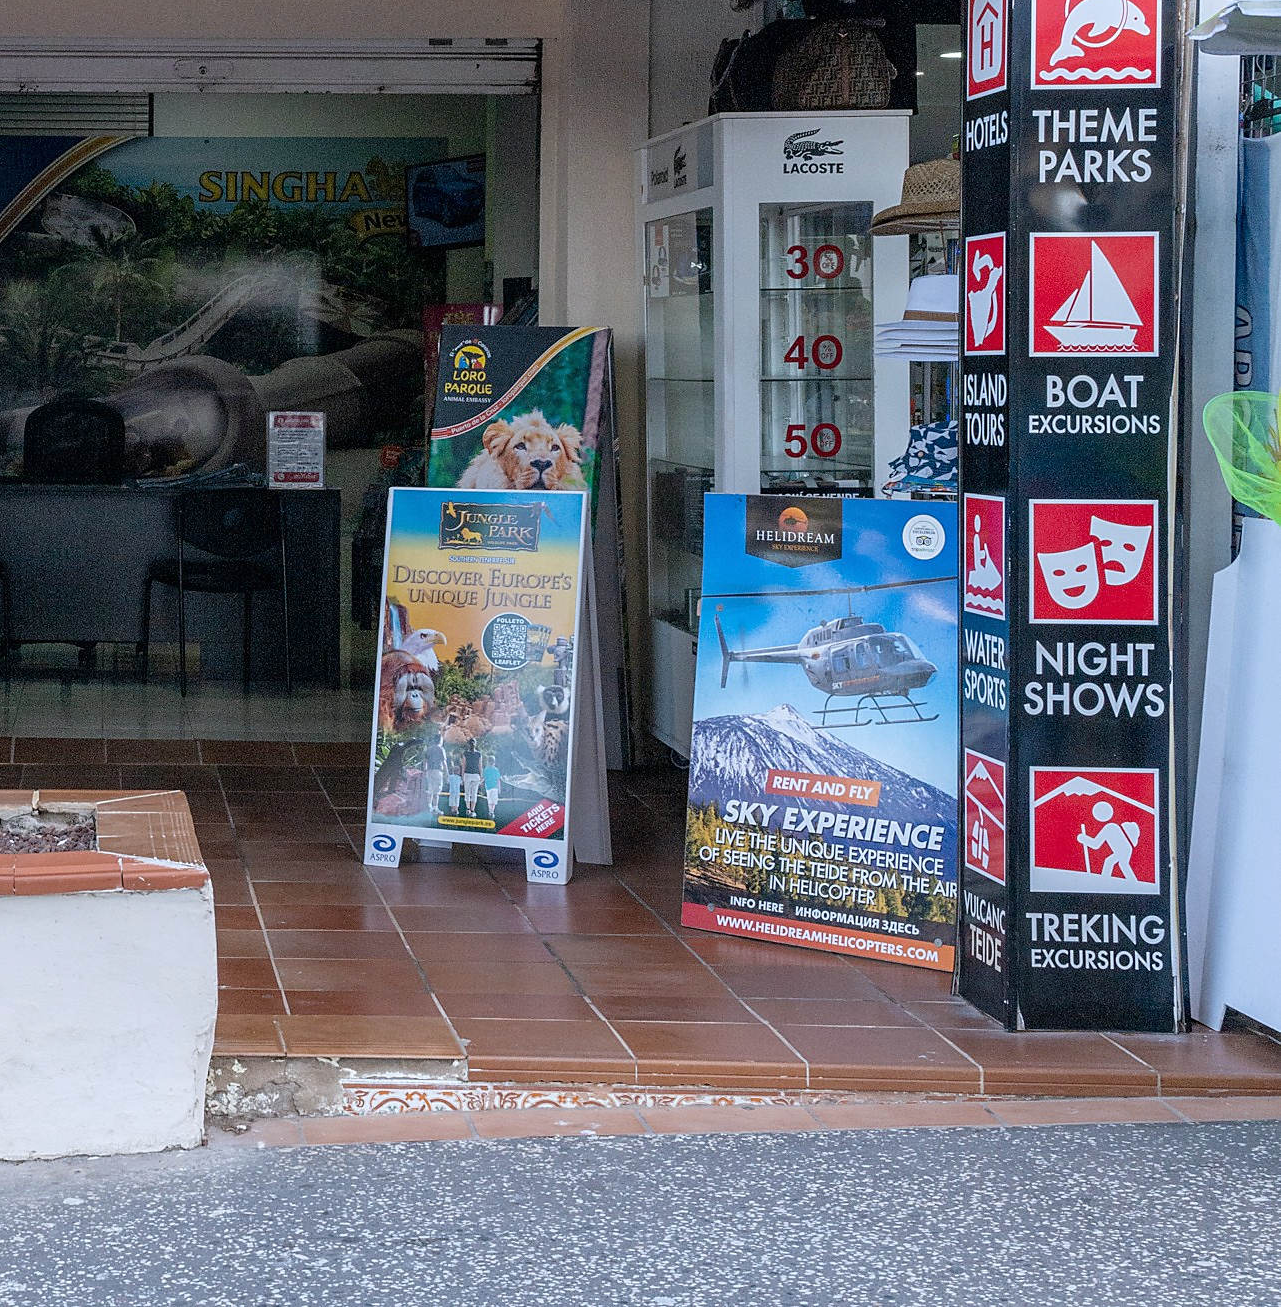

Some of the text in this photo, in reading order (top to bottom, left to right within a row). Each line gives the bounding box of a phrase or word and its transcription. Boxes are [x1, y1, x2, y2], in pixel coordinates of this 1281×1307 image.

[966, 110, 1008, 152] HOTELS
[1032, 107, 1157, 143] THEME
[783, 162, 844, 175] LACOSTE
[1039, 149, 1152, 183] PARKS
[199, 171, 373, 203] SINGHA
[786, 244, 844, 280] 30
[784, 334, 843, 370] 40
[445, 383, 493, 396] PARQUE
[453, 370, 486, 381] LORO
[963, 373, 1007, 407] ISLAND
[1046, 374, 1144, 408] BOAT
[784, 422, 842, 458] 50
[965, 413, 1004, 446] TOURS
[1028, 415, 1161, 435] EXCURSIONS
[447, 510, 519, 530] JUNGLE
[489, 525, 534, 542] PARK
[756, 530, 835, 544] HELIDREAM
[407, 589, 478, 608] UNIQUE
[965, 628, 1005, 670] WATER
[1036, 640, 1154, 676] NIGHT
[964, 668, 1006, 711] SPORTS
[1024, 681, 1165, 718] SHOWS
[772, 776, 874, 800] RENT AND FLY
[520, 803, 560, 833] TICKETS
[535, 817, 556, 834] HERE
[723, 799, 945, 851] SKY EXPERIENCE
[370, 853, 396, 862] ASPRO
[716, 827, 943, 876] LIVE THE UNIQUE EXPERIENCE
[531, 870, 558, 879] ASPRO
[699, 845, 957, 899] OF SEEING THE TEIDE FROM THE AIR
[730, 896, 784, 913] INFO HERE
[770, 875, 875, 905] IN HELICOPTER
[795, 906, 920, 936] ИНФОРМАЦИЯ ЗДЕСЬ
[1026, 912, 1165, 945] TREKING
[716, 914, 939, 962] WWW.HELIDREAMHELICOPTERS.COM
[969, 924, 1002, 972] TEIDE
[1031, 949, 1164, 971] EXCURSIONS
